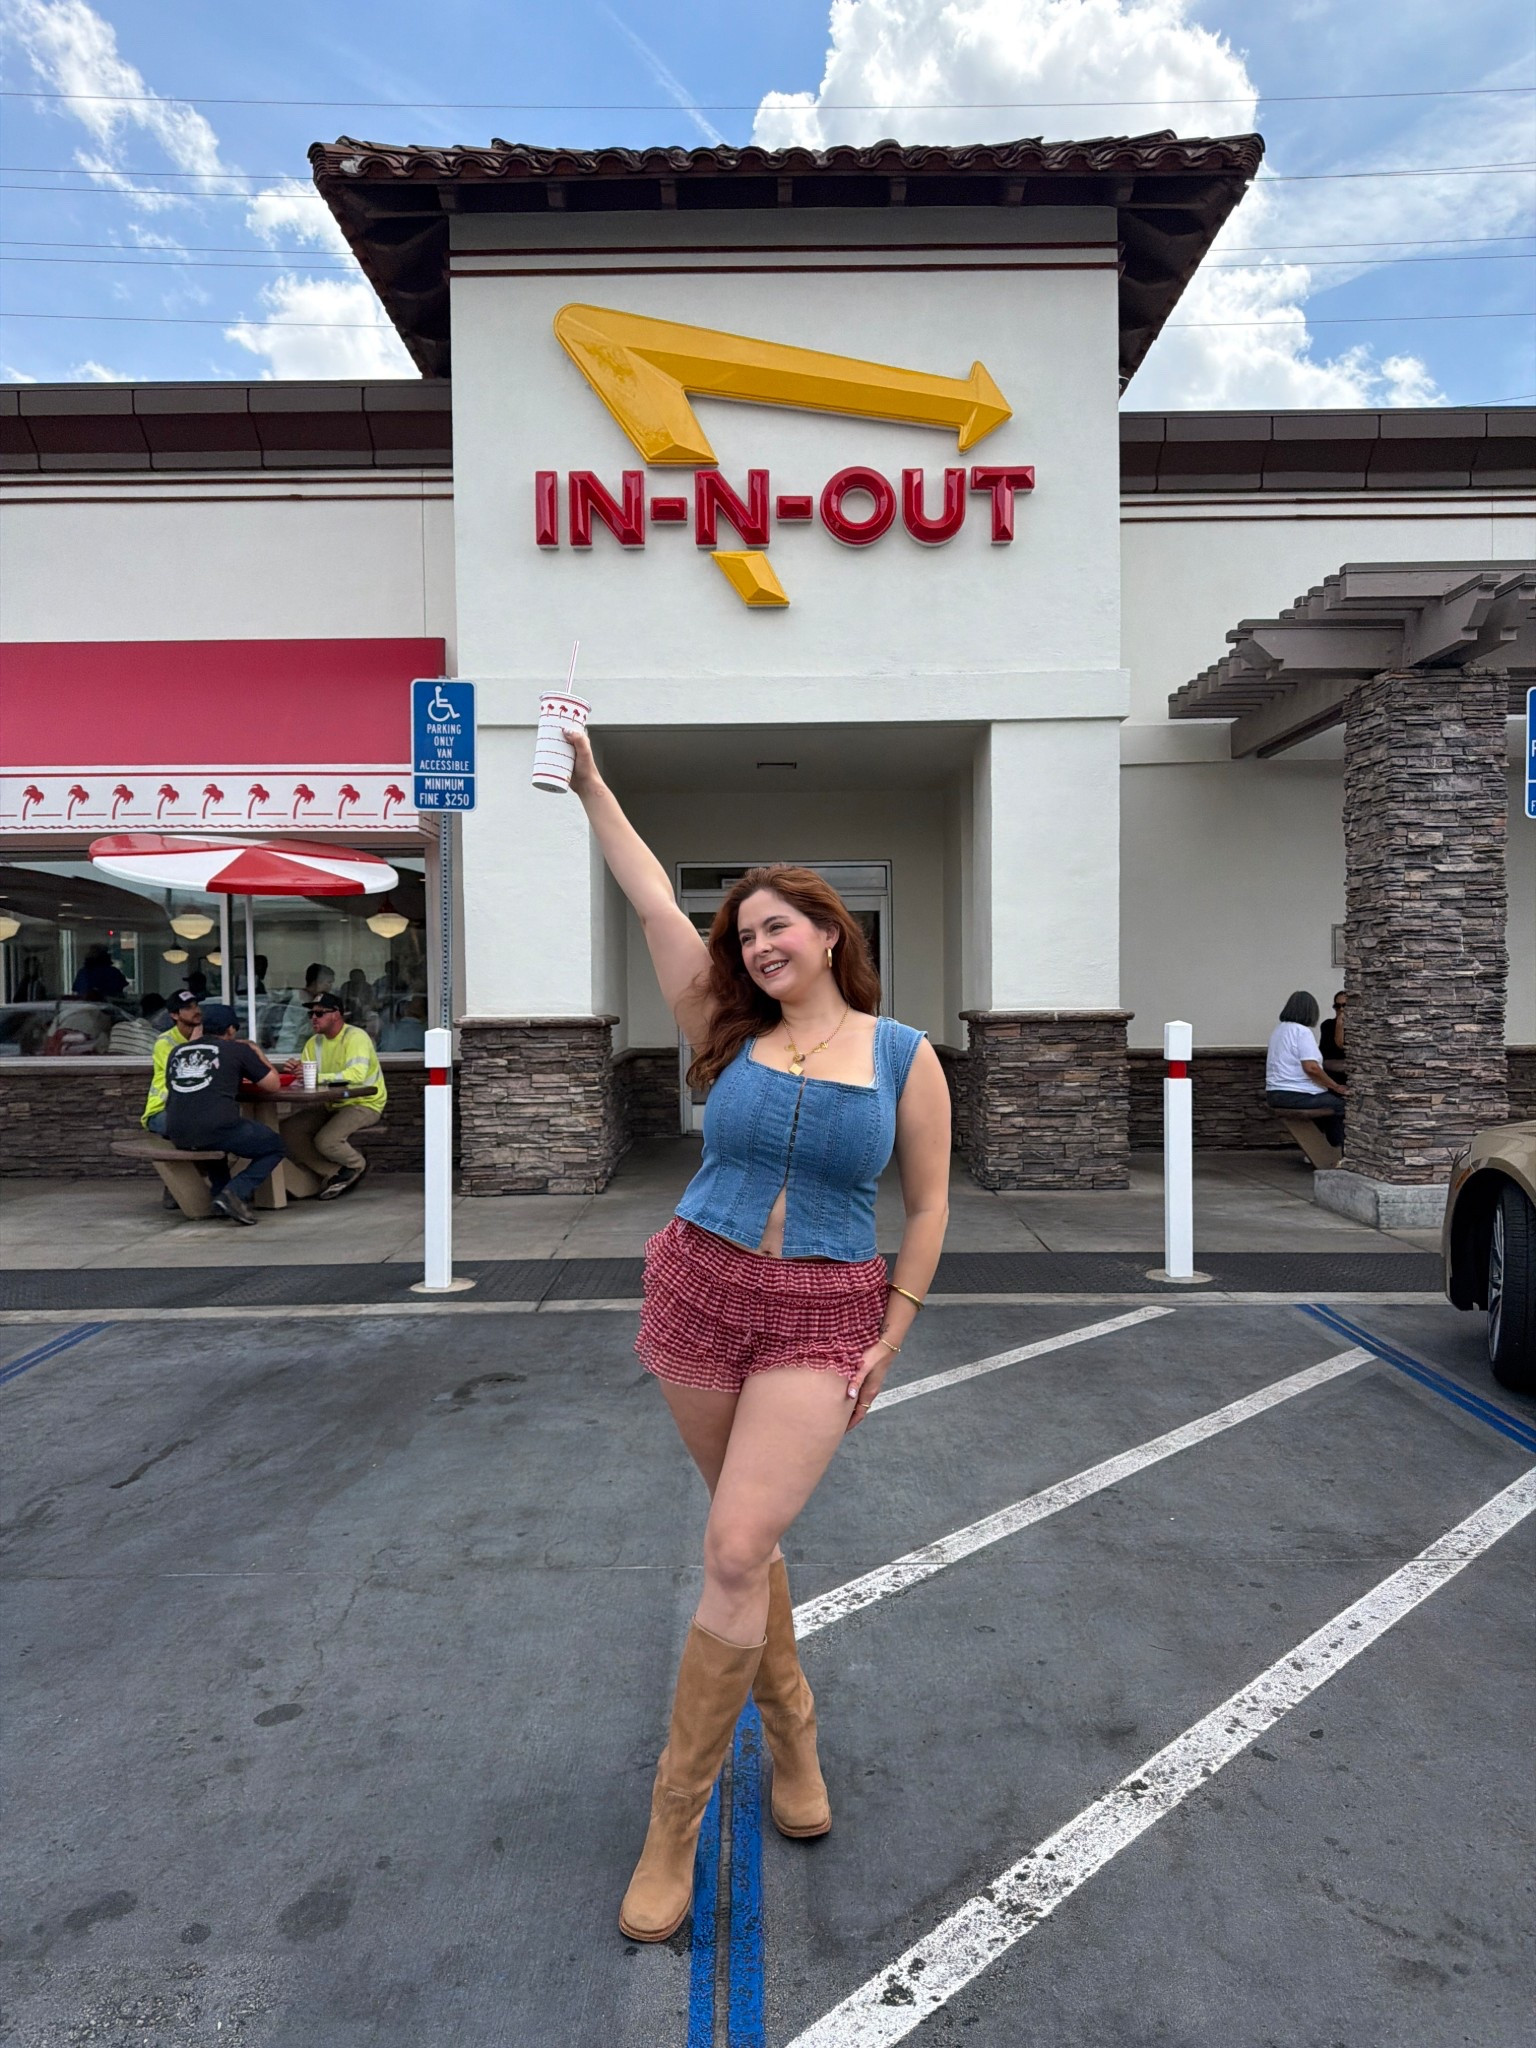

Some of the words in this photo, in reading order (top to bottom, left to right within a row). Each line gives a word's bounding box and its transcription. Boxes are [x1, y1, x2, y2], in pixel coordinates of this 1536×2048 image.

[535, 465, 1035, 549] IN-N-OUT
[427, 724, 461, 734] PARKING
[434, 736, 454, 746] ONLY
[437, 748, 452, 758] VAN
[419, 760, 469, 771] ACCESSIBLE
[424, 778, 464, 791] MINIMUM
[419, 792, 439, 806] FINE
[445, 792, 469, 807] $250
